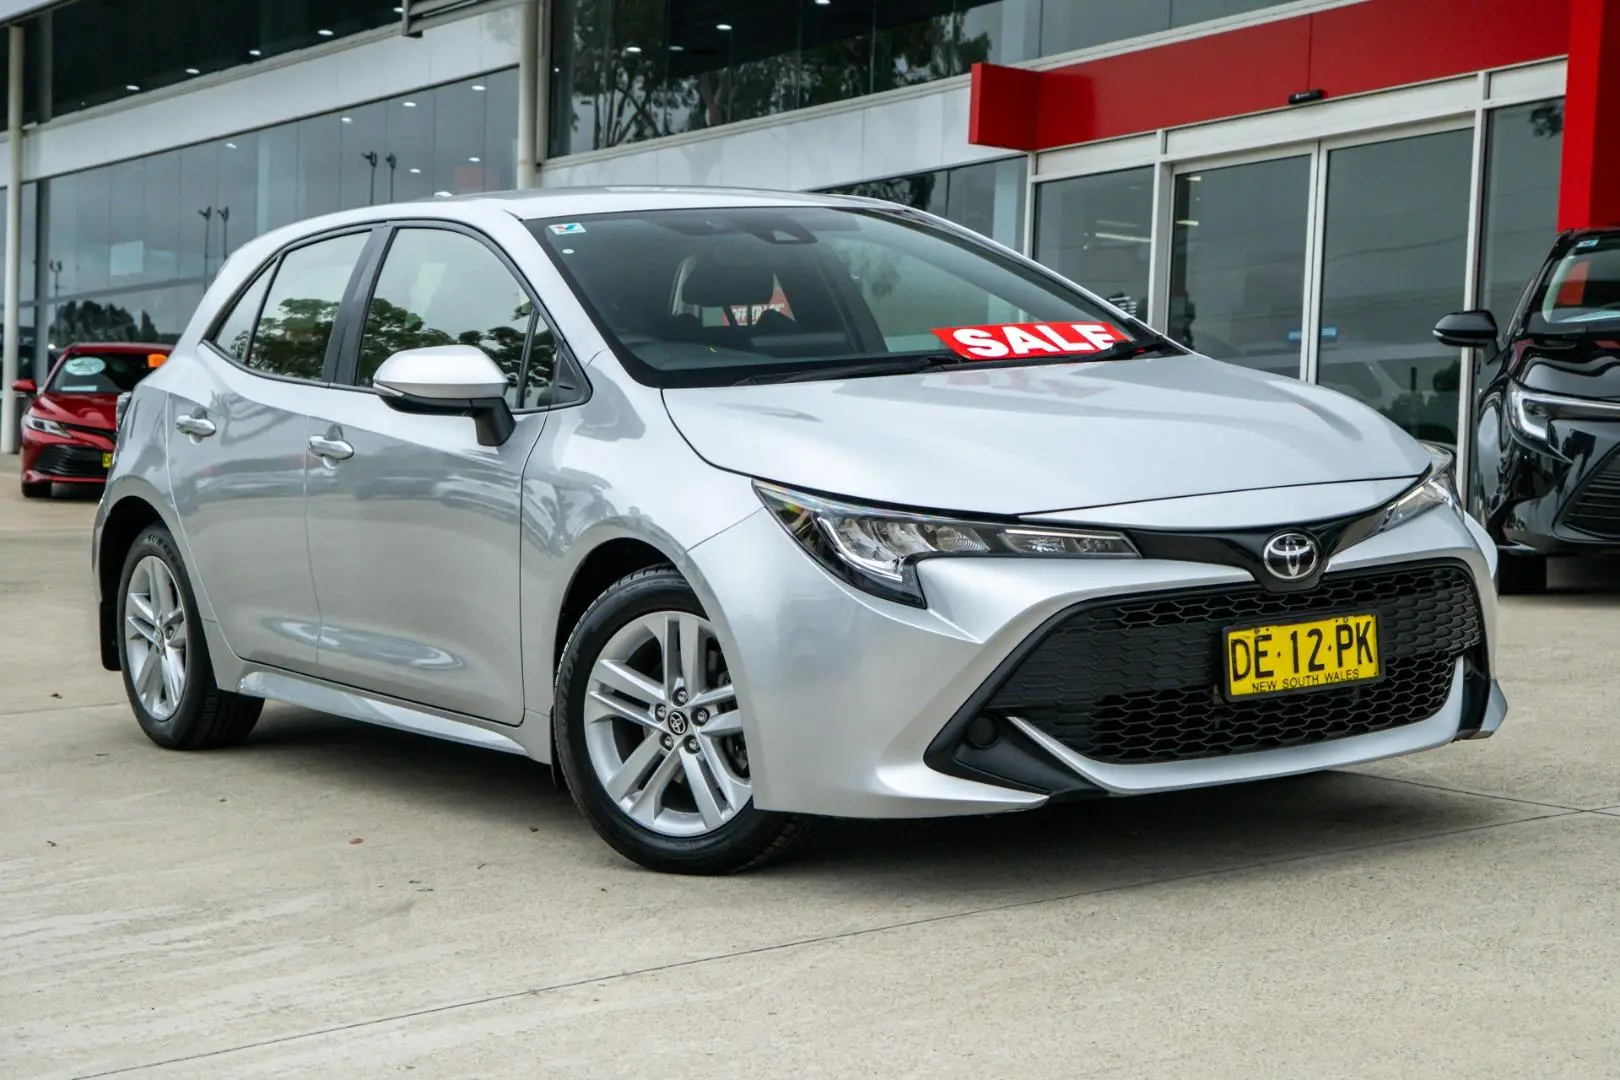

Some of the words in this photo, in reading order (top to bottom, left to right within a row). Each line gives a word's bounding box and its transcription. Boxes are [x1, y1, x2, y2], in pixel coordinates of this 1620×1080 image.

[952, 324, 1115, 357] SALE
[1251, 680, 1277, 693] NEW
[1282, 674, 1319, 689] SOUTH
[1324, 668, 1360, 684] WALES
